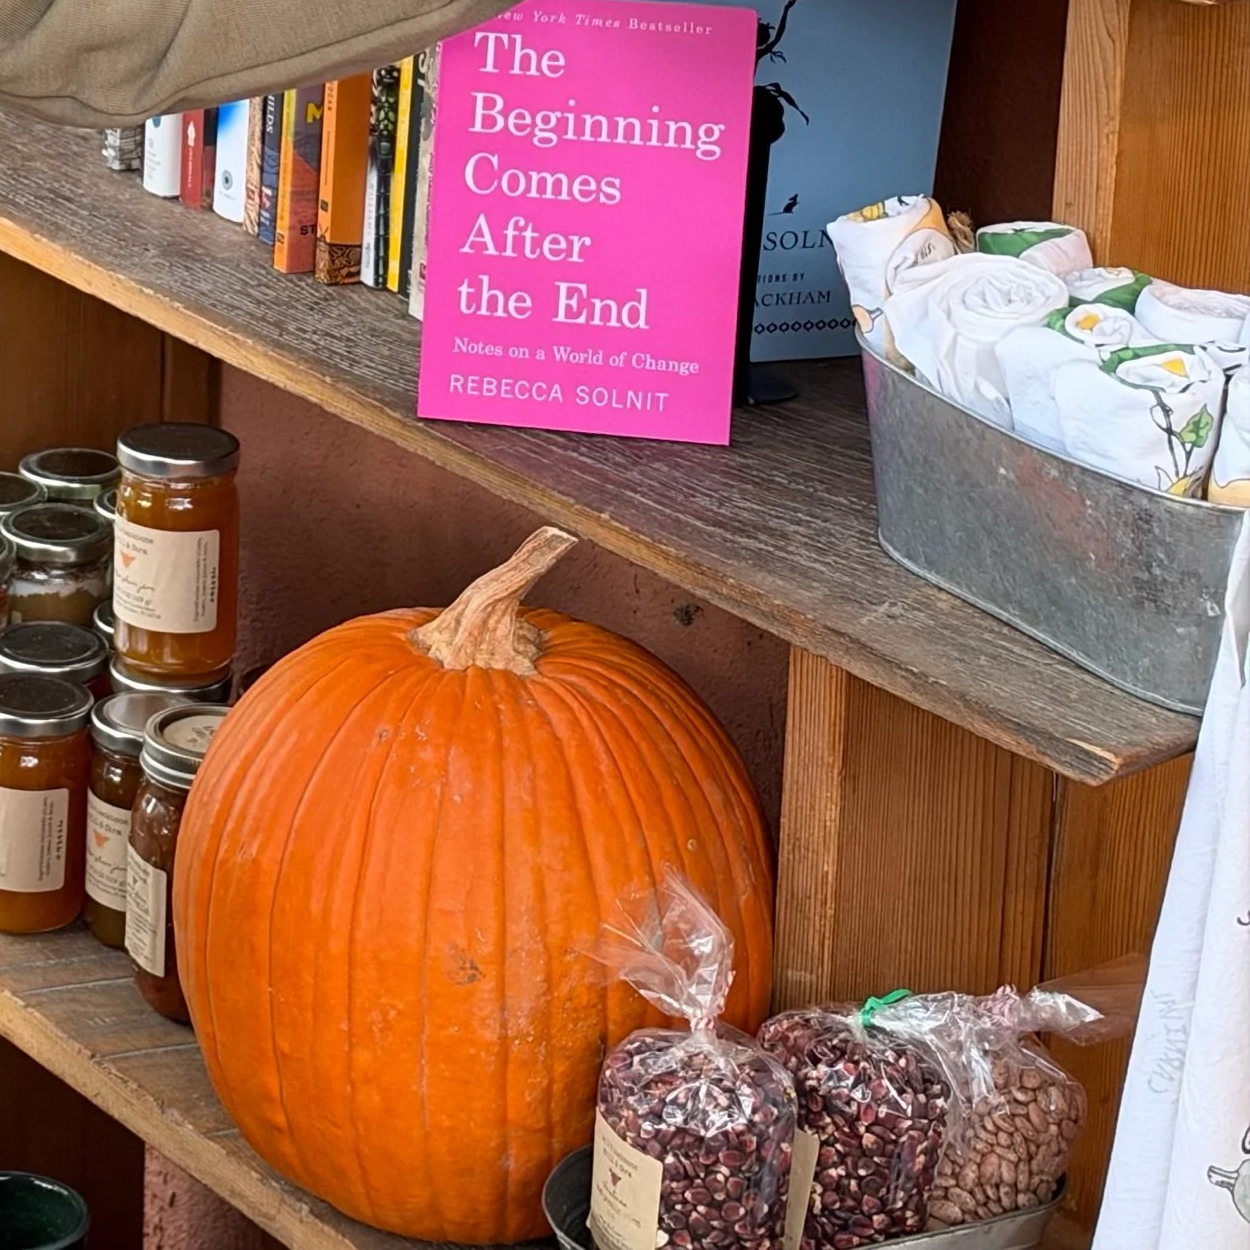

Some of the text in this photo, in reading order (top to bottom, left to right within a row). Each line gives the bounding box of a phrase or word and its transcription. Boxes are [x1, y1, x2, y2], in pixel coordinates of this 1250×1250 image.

[497, 10, 713, 36] ew York Times Bestseller
[473, 31, 566, 78] The
[468, 91, 726, 161] Beginning
[464, 152, 621, 205] Comes
[459, 212, 592, 263] After
[457, 274, 650, 330] the End
[453, 336, 700, 376] Notes on a World of Change
[450, 373, 670, 412] REBECCA SOLNIT
